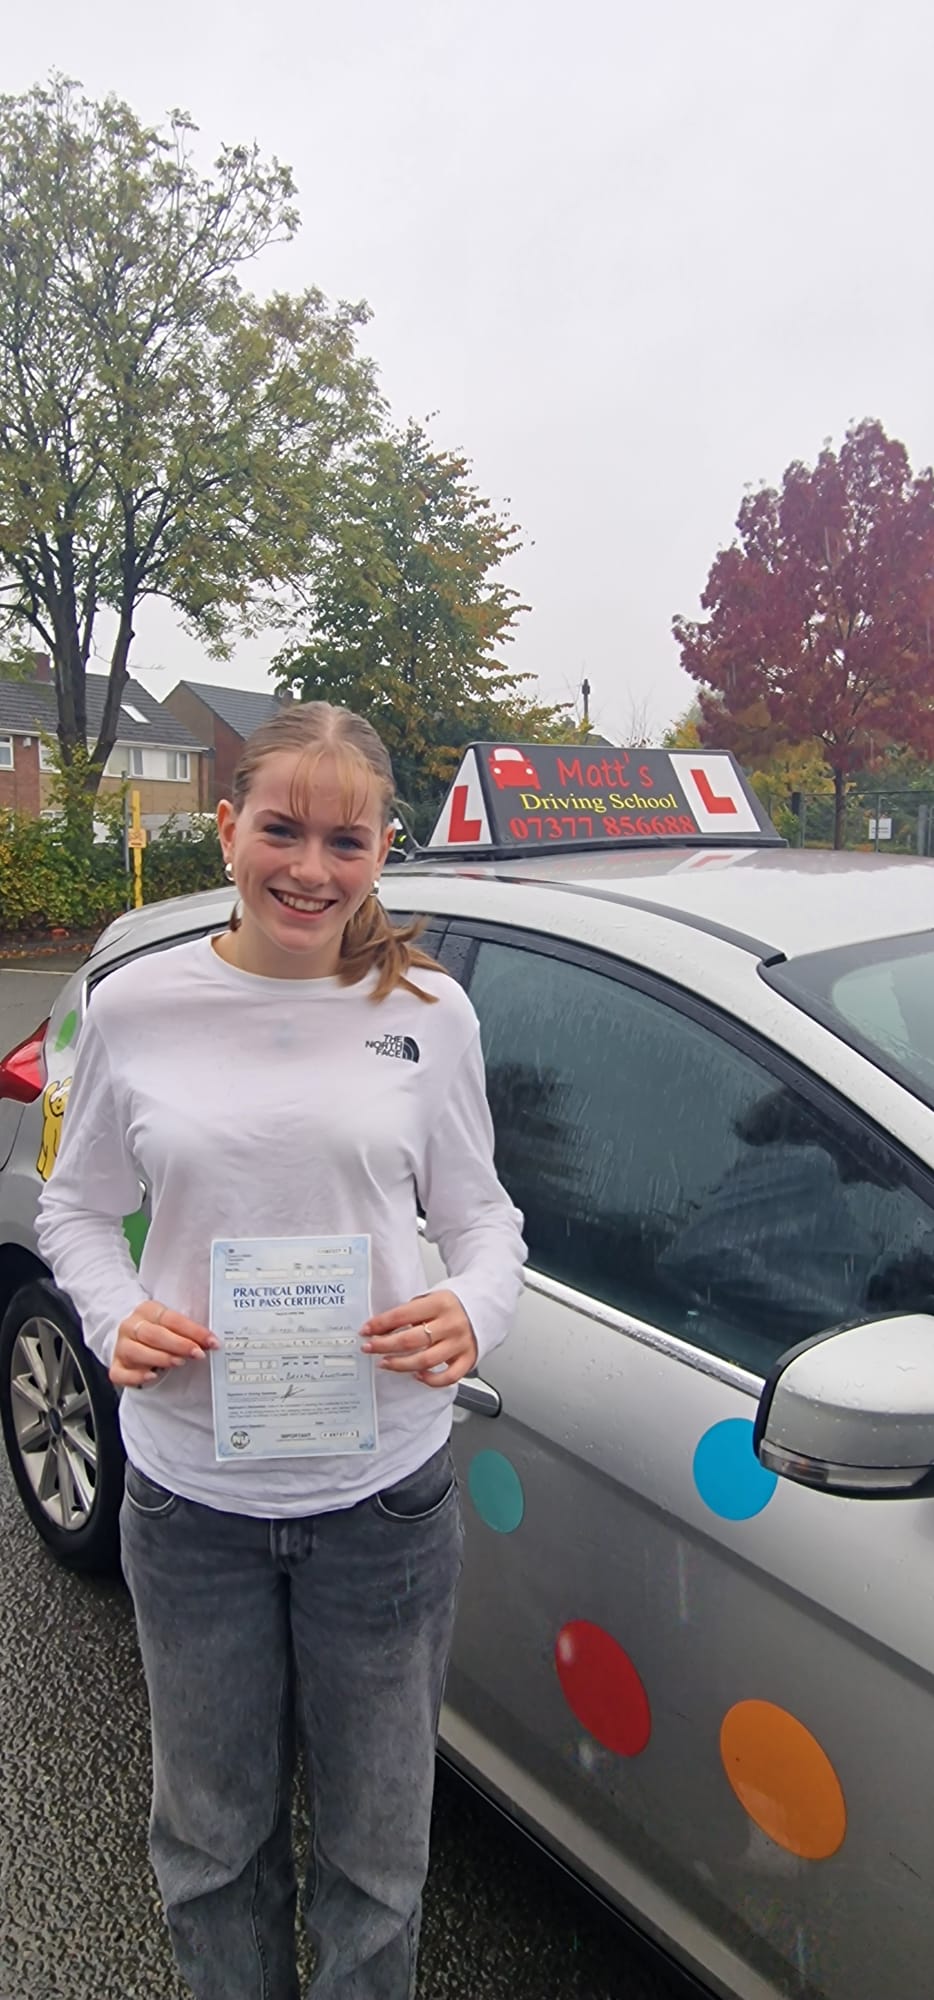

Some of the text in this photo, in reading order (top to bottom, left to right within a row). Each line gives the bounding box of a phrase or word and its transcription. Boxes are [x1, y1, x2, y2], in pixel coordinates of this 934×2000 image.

[557, 752, 654, 788] Matt's
[690, 768, 738, 814] L
[519, 793, 678, 813] Driving School
[447, 785, 482, 843] L
[509, 815, 697, 840] 07377 856688
[365, 1040, 403, 1051] NORTH
[384, 1034, 403, 1043] THE
[375, 1047, 401, 1059] FACE
[233, 1283, 346, 1297] PRACTICAL DRIVING
[233, 1295, 345, 1308] TEST PASS CERTIFICATE
